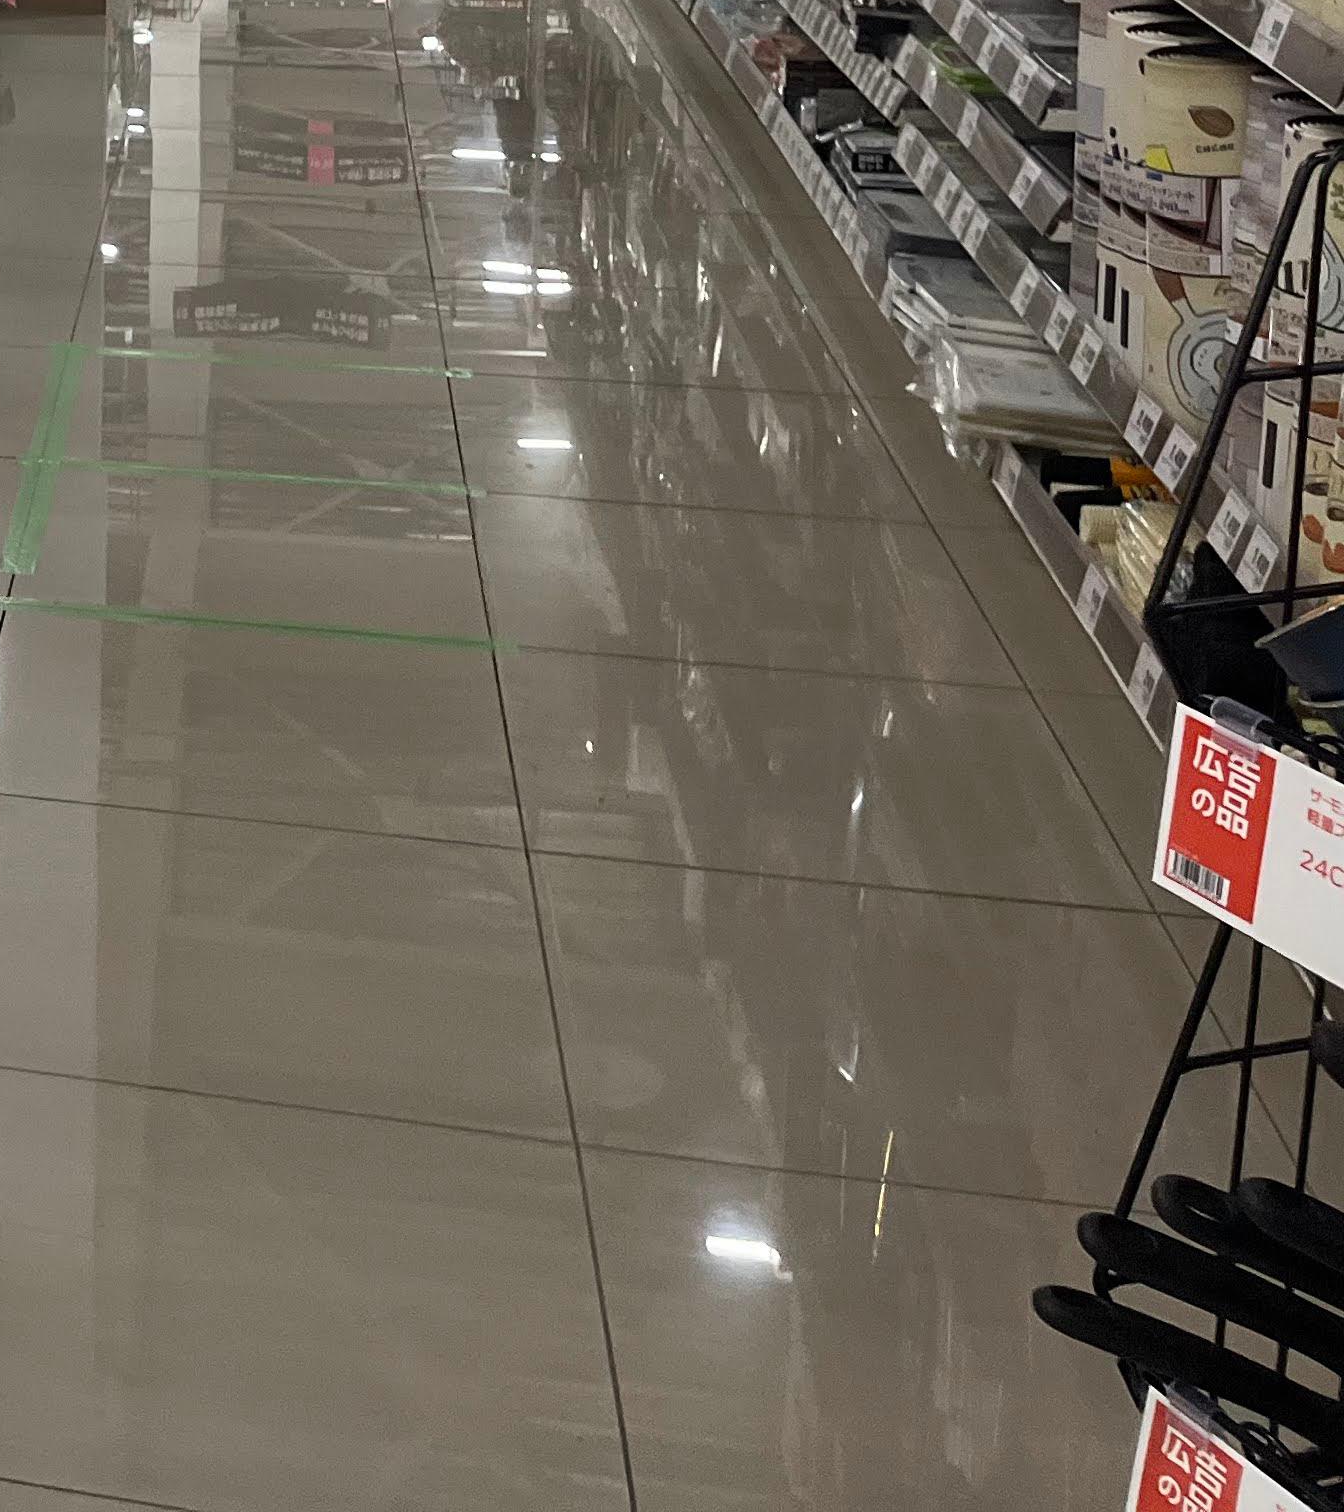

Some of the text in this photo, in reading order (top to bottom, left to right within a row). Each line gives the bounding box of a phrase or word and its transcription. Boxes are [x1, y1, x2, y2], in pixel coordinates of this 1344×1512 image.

[1192, 735, 1261, 800] 広告
[1191, 786, 1249, 840] の品
[1161, 1424, 1228, 1500] 広告
